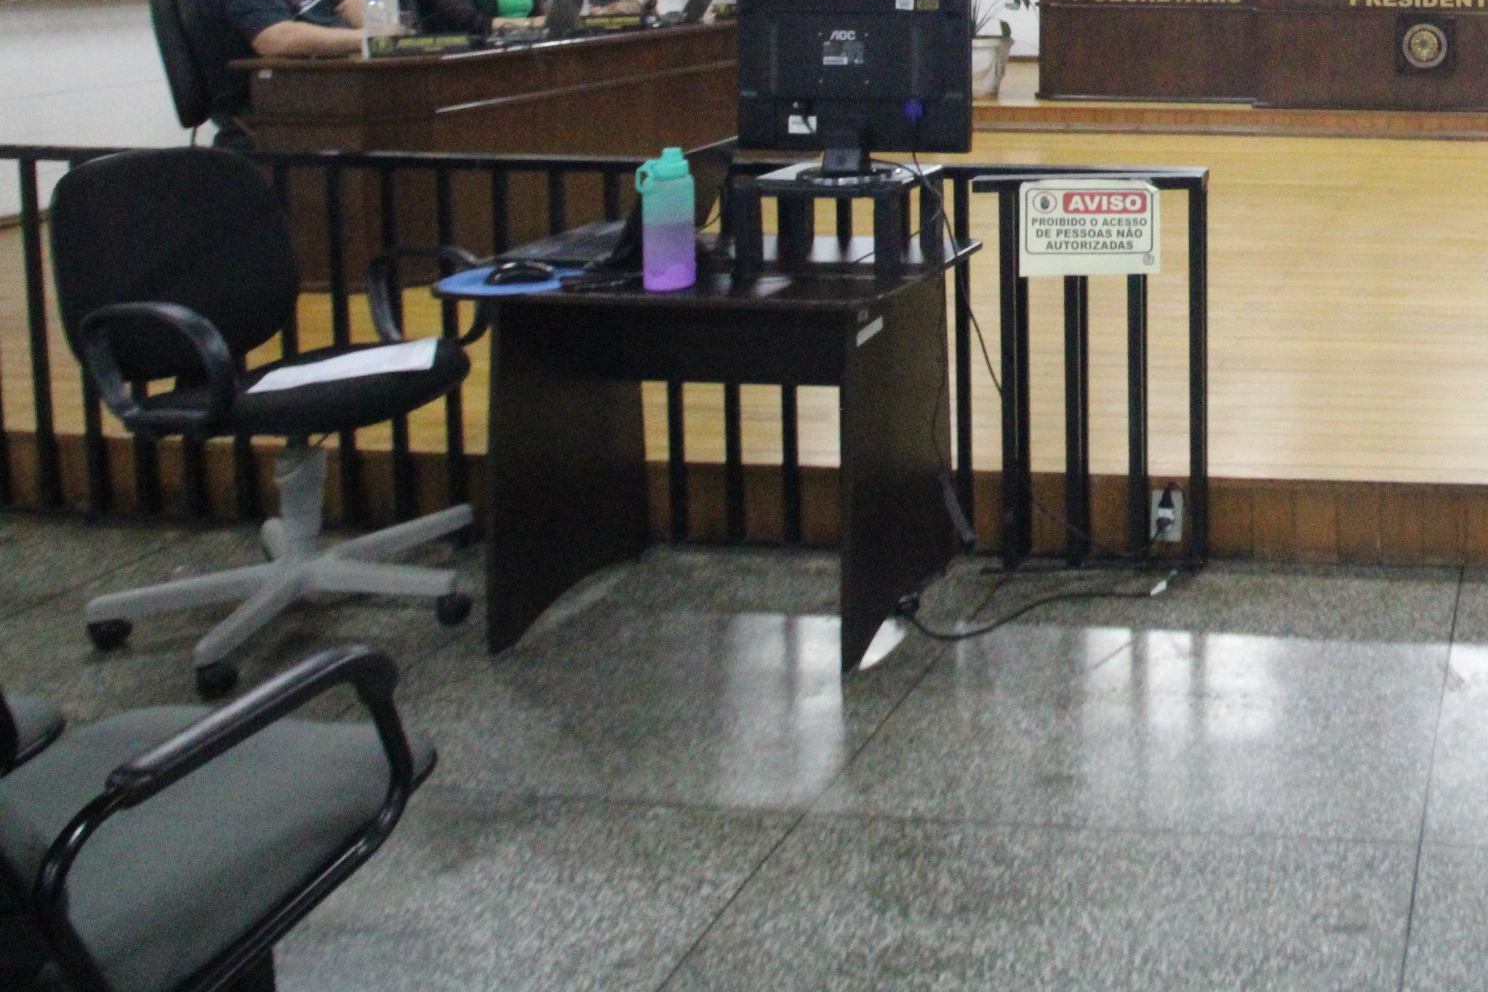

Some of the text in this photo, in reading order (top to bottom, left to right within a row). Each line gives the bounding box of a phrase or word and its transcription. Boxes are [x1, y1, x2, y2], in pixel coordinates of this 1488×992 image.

[830, 30, 856, 41] AOC
[1068, 195, 1142, 211] AVISO
[1031, 217, 1147, 227] PROIBIDO O ACESSO
[1036, 227, 1143, 238] DE PESSOAS NÃO
[1046, 240, 1134, 250] AUTORIZADAS
